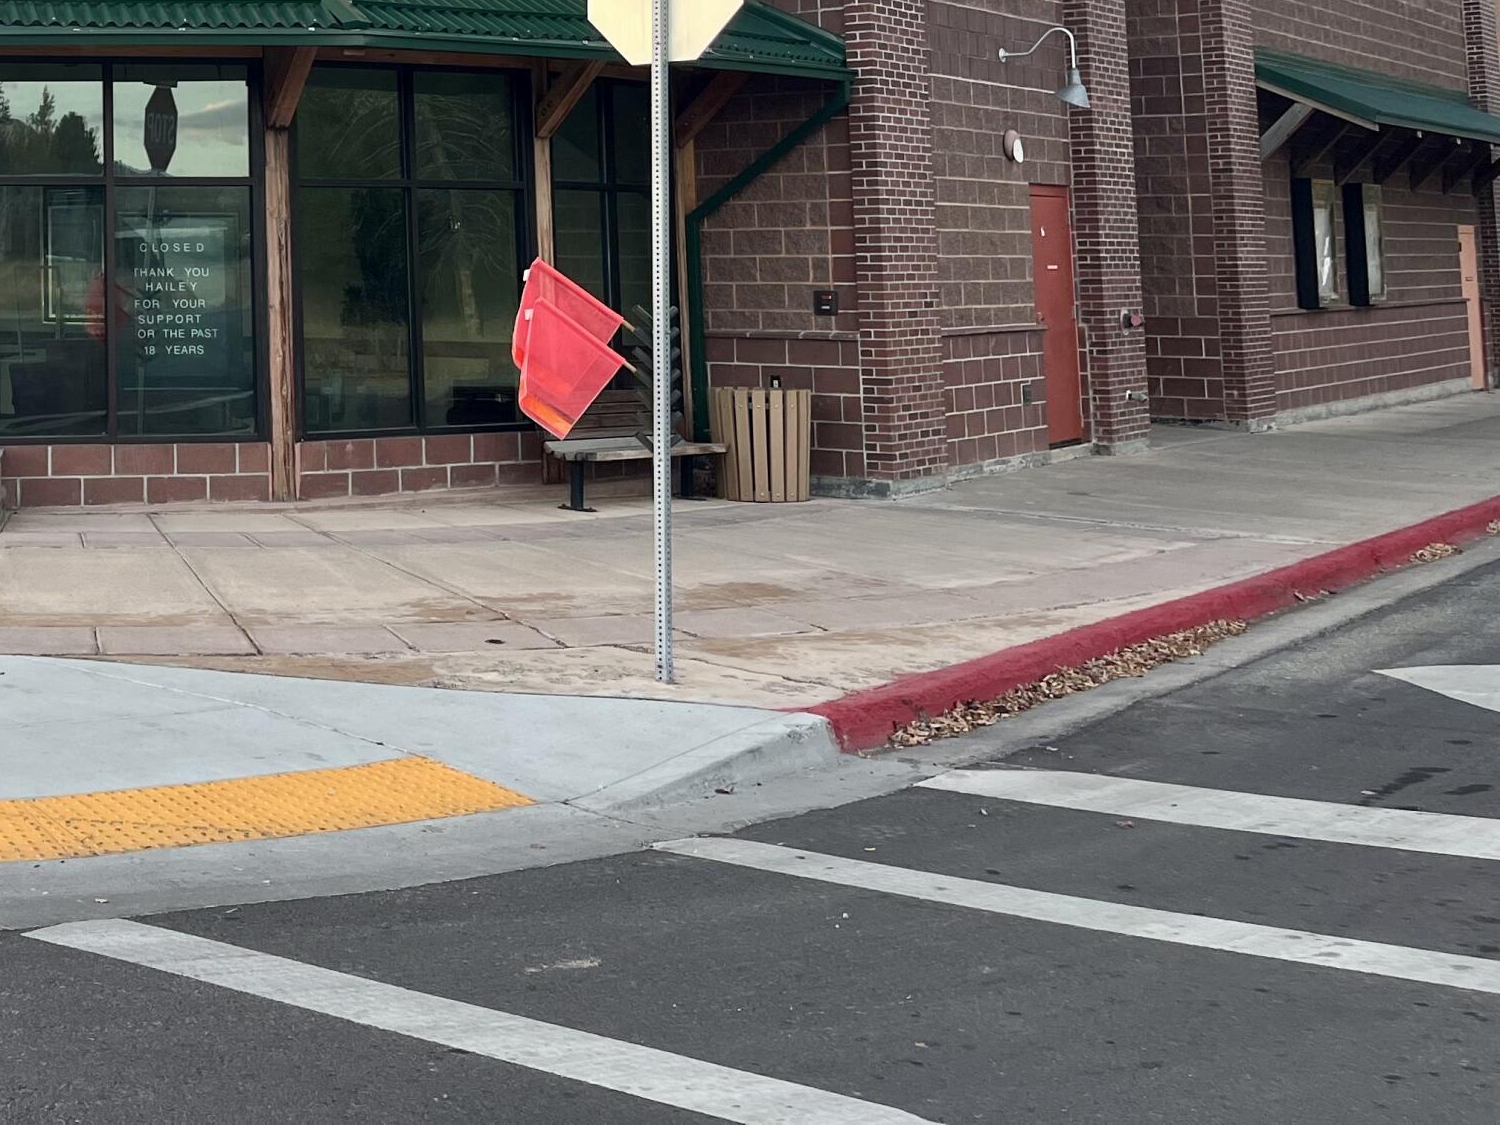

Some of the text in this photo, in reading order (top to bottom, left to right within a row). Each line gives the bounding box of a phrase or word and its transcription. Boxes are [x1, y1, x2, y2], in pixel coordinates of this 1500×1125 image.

[139, 243, 204, 252] CLOSED
[133, 267, 209, 277] THANK YOU
[145, 282, 197, 291] HAILEY
[134, 299, 206, 309] FOR YOUR
[138, 314, 201, 324] SUPPORT
[163, 329, 185, 338] THE
[191, 328, 218, 338] PAST
[144, 345, 204, 355] 18 YEARS
